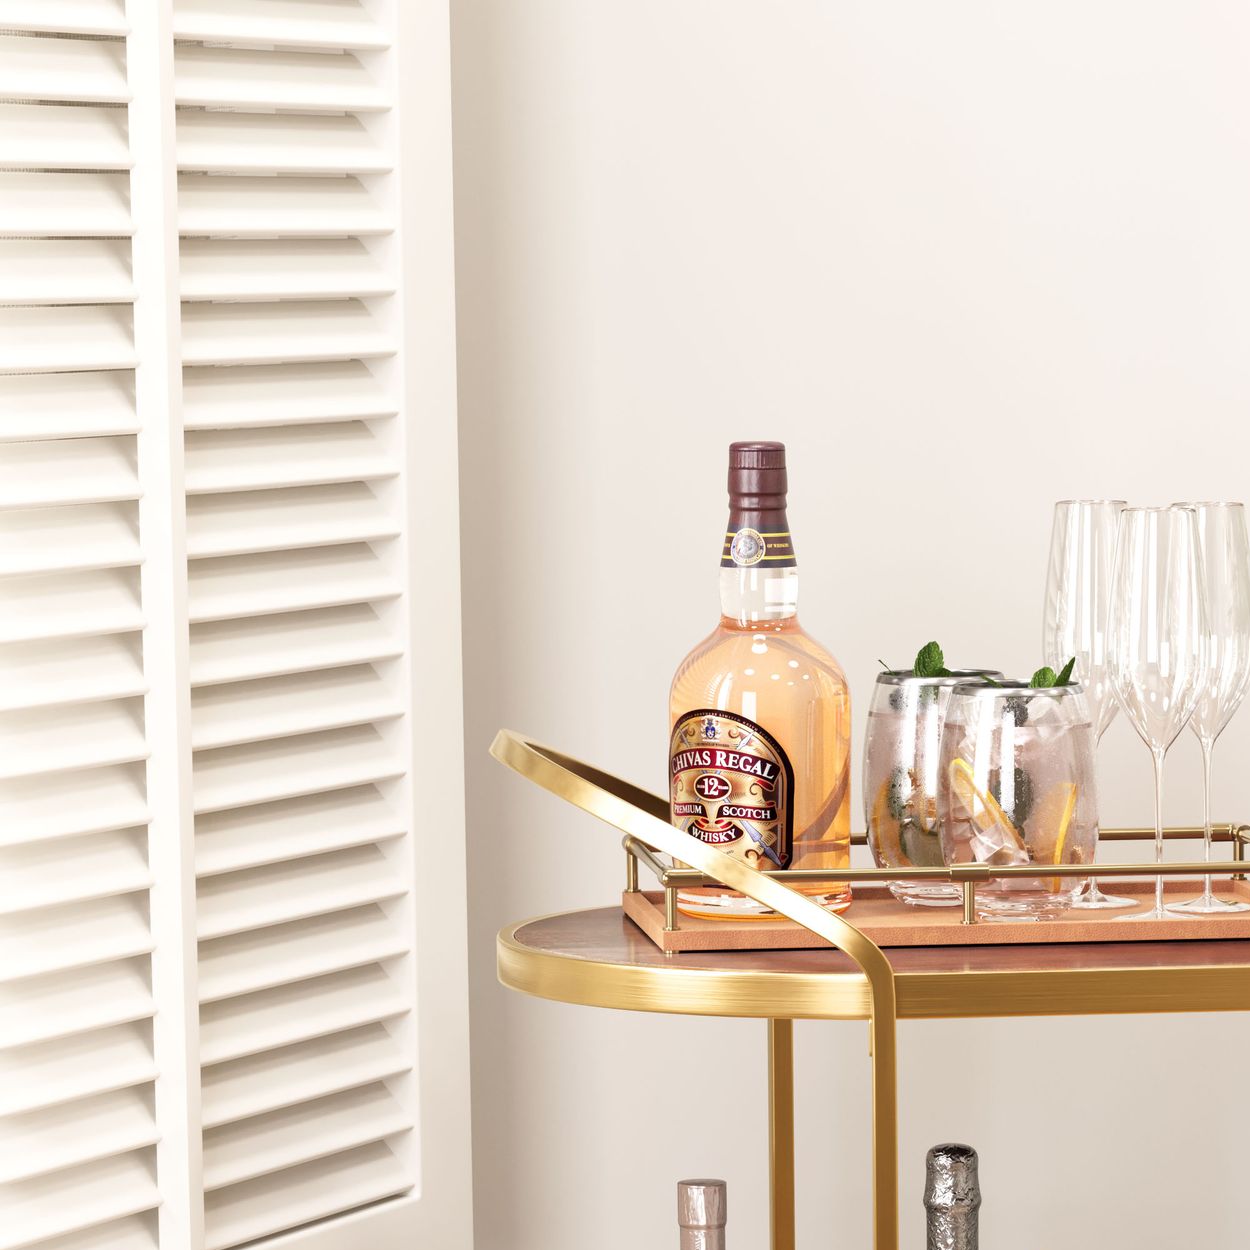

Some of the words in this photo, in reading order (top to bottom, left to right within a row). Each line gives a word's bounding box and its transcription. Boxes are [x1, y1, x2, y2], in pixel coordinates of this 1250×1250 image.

[672, 750, 711, 774] CHIVAS
[715, 750, 774, 780] REGAL
[703, 777, 719, 796] 12
[674, 804, 702, 814] PREMIUM
[722, 806, 771, 819] SCOTCH
[692, 826, 736, 843] WHISKY
